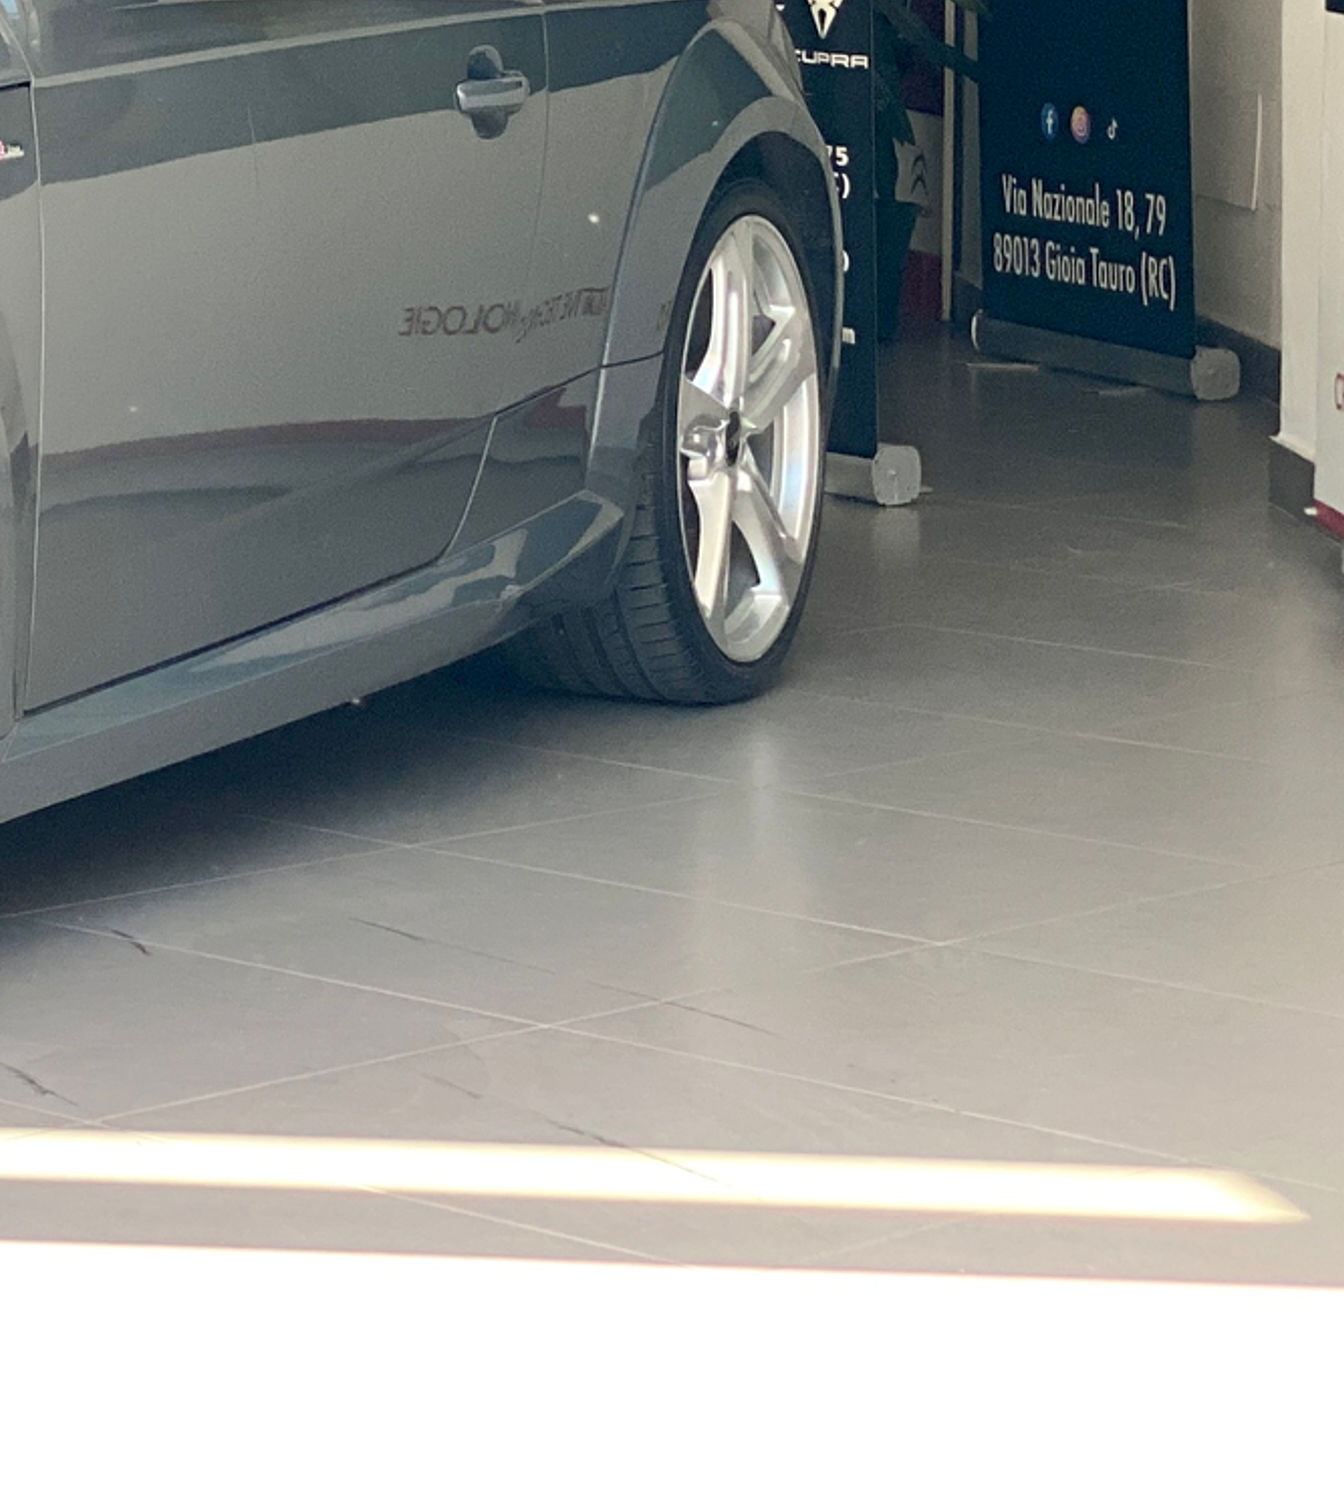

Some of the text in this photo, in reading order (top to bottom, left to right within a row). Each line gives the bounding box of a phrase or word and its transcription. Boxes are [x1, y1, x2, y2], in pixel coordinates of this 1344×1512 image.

[1002, 173, 1027, 216] Via
[1031, 177, 1110, 228] Nazionale
[993, 231, 1176, 312] 89013 Gioia Tauro (RC)
